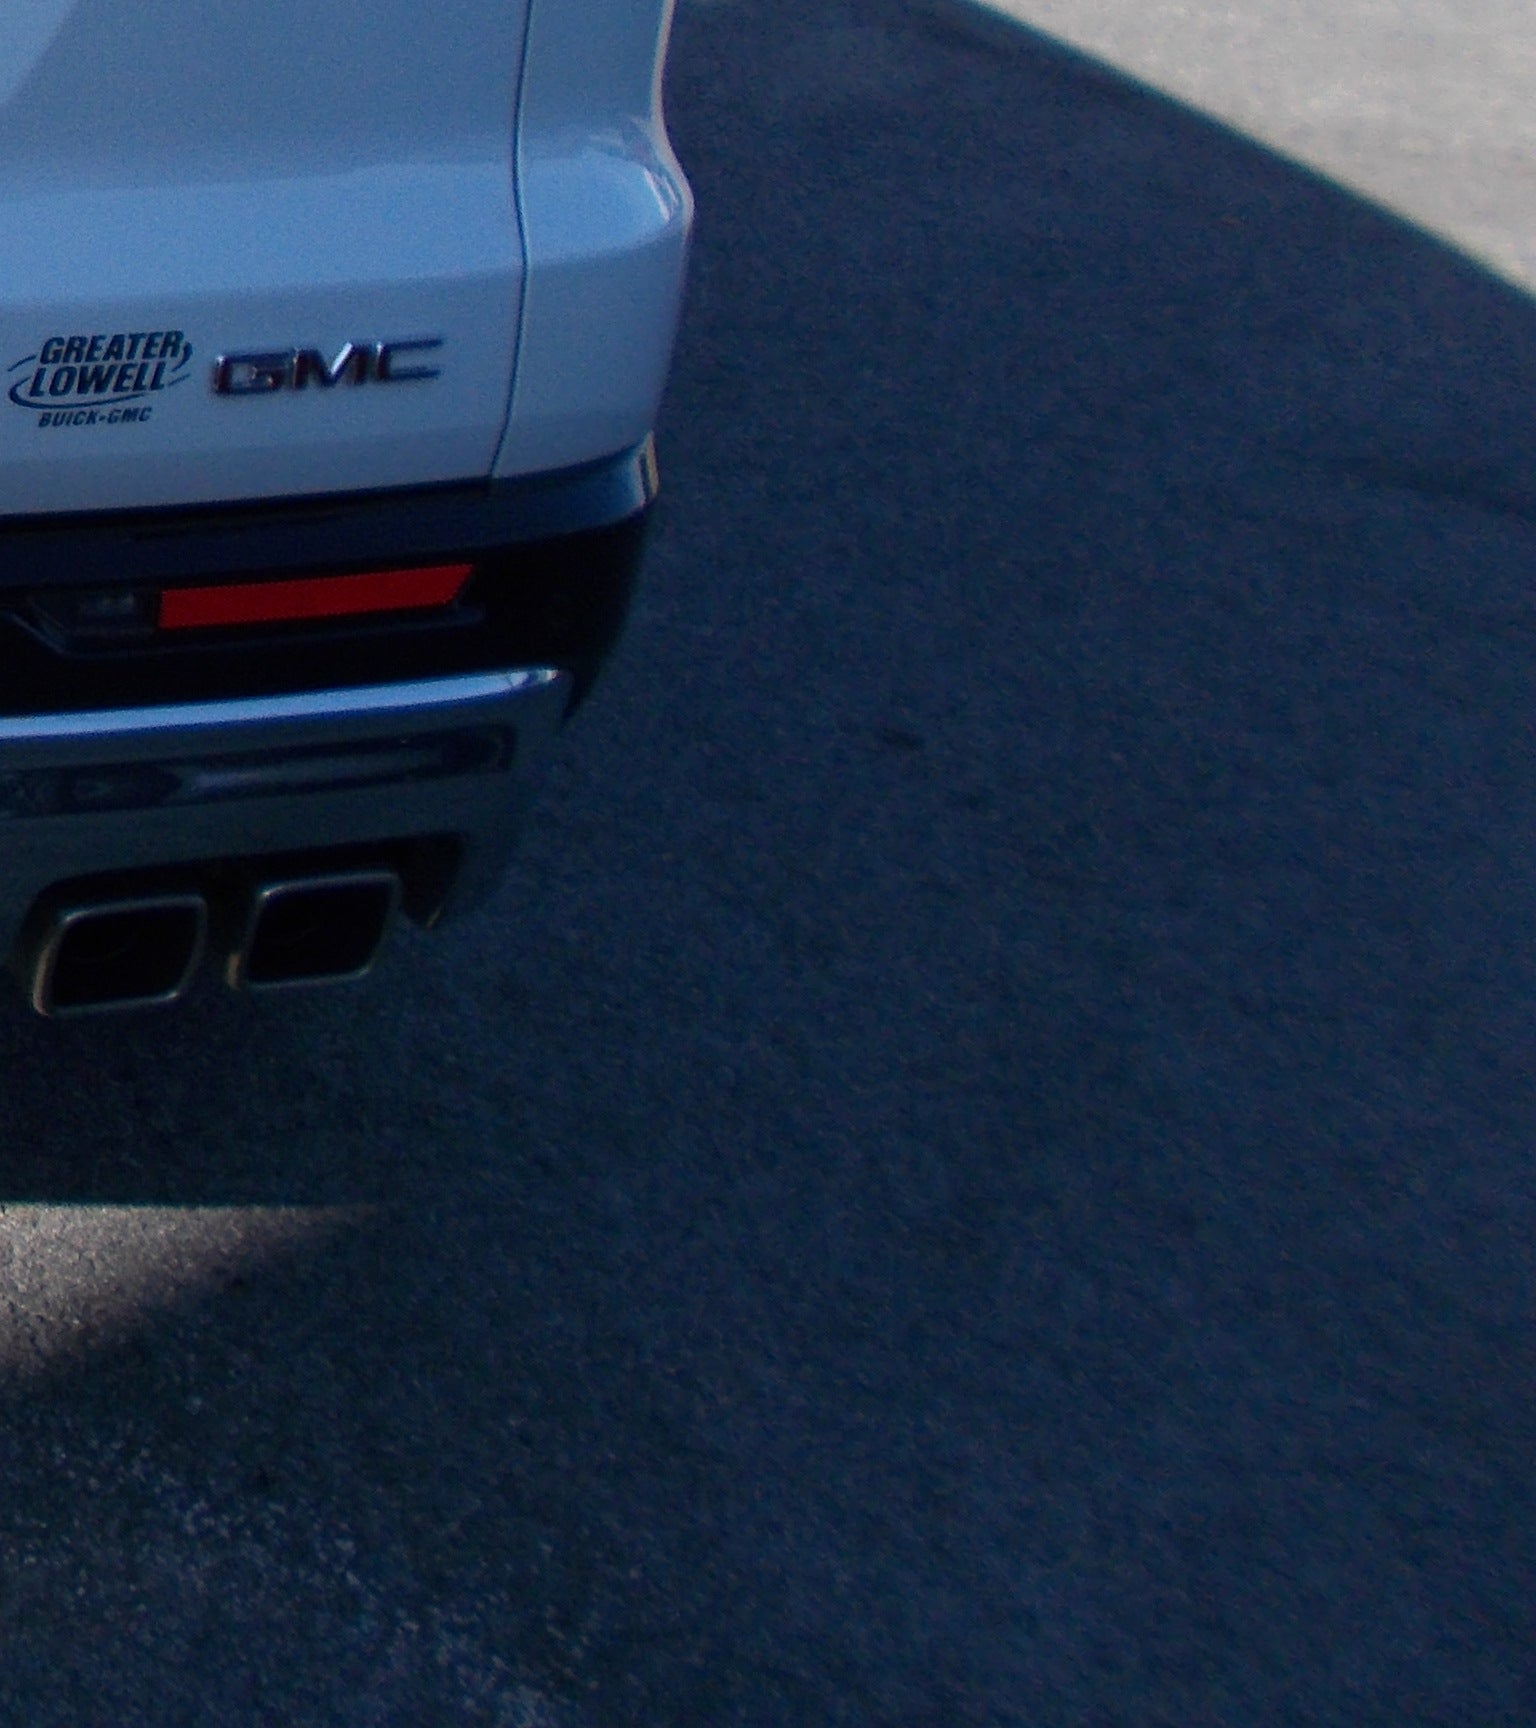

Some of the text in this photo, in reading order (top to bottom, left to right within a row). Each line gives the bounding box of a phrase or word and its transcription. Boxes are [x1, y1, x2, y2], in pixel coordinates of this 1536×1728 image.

[39, 329, 185, 365] GREATER
[29, 363, 168, 397] LOWELL
[212, 337, 444, 397] GMC
